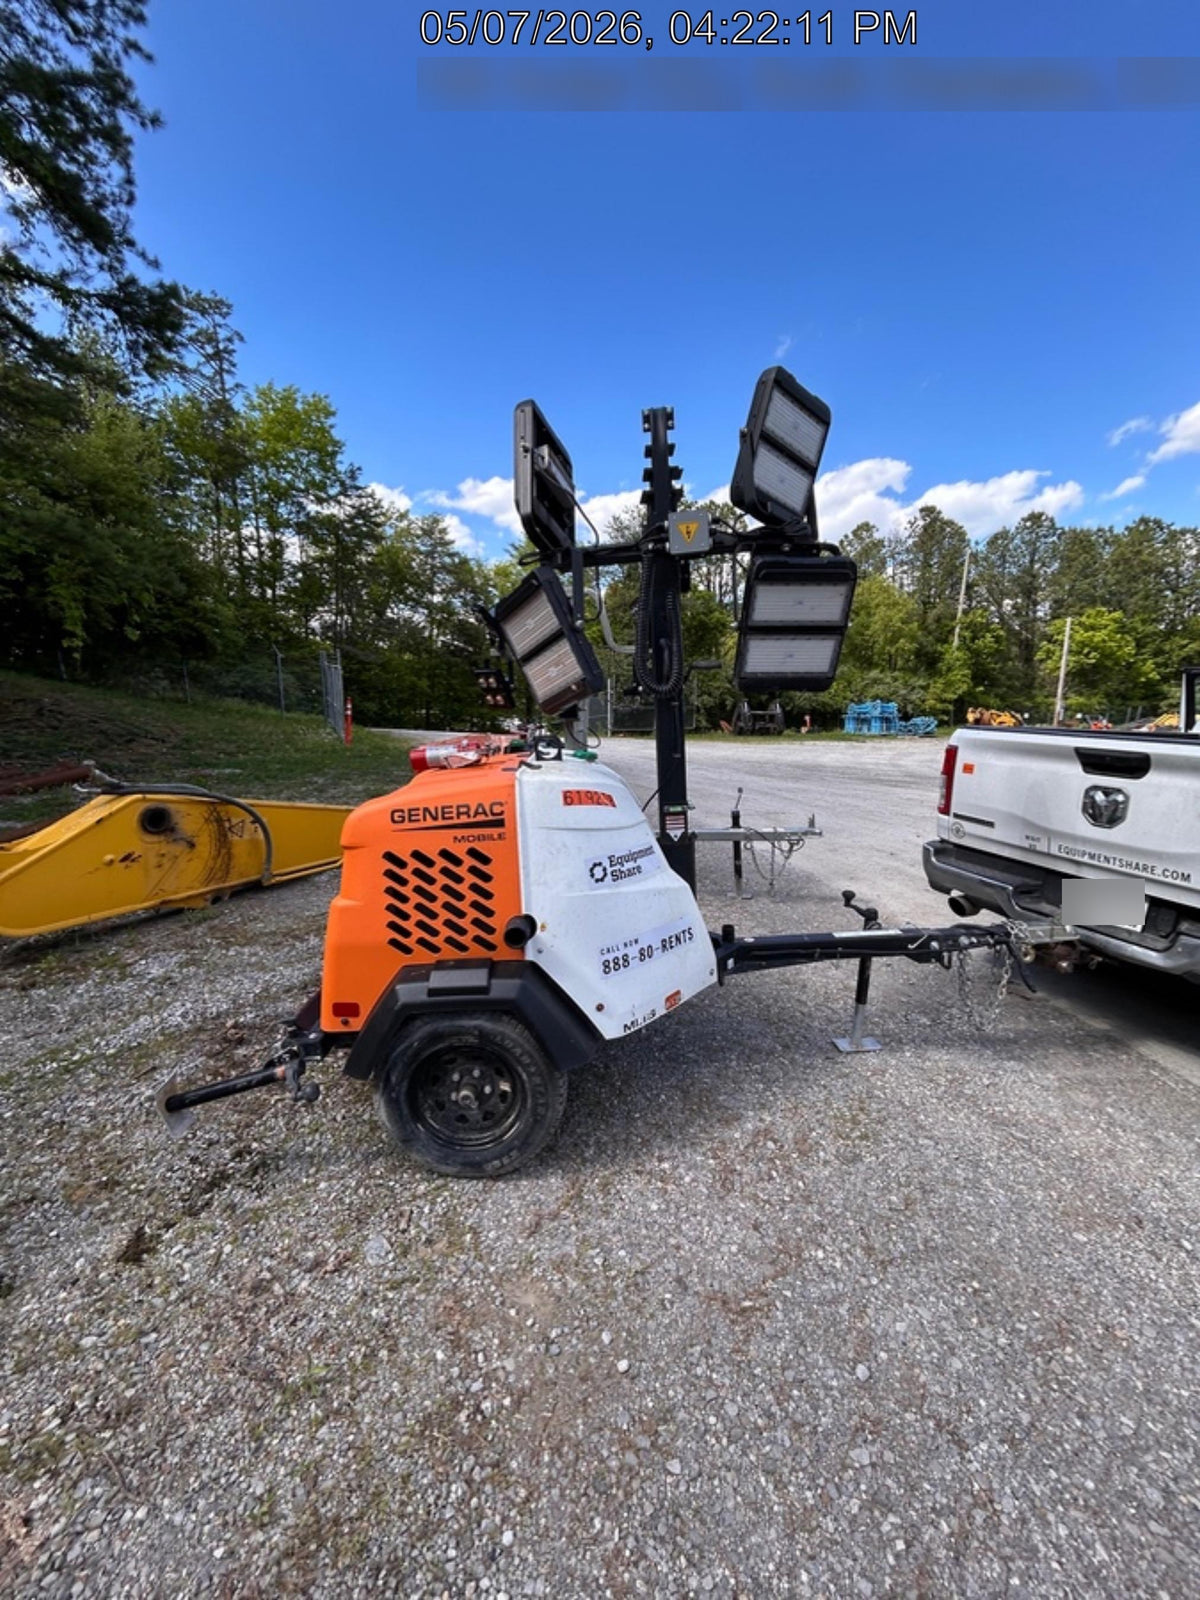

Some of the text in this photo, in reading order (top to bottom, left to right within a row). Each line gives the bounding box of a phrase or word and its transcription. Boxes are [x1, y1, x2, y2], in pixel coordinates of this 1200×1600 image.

[390, 801, 505, 825] GENERAC
[453, 832, 506, 844] MOBILE
[610, 864, 643, 882] Share
[1057, 844, 1192, 883] EQUIPMENTSHARE.COM
[600, 937, 640, 956] CALL NOW
[601, 926, 695, 975] 888-80-RENTS
